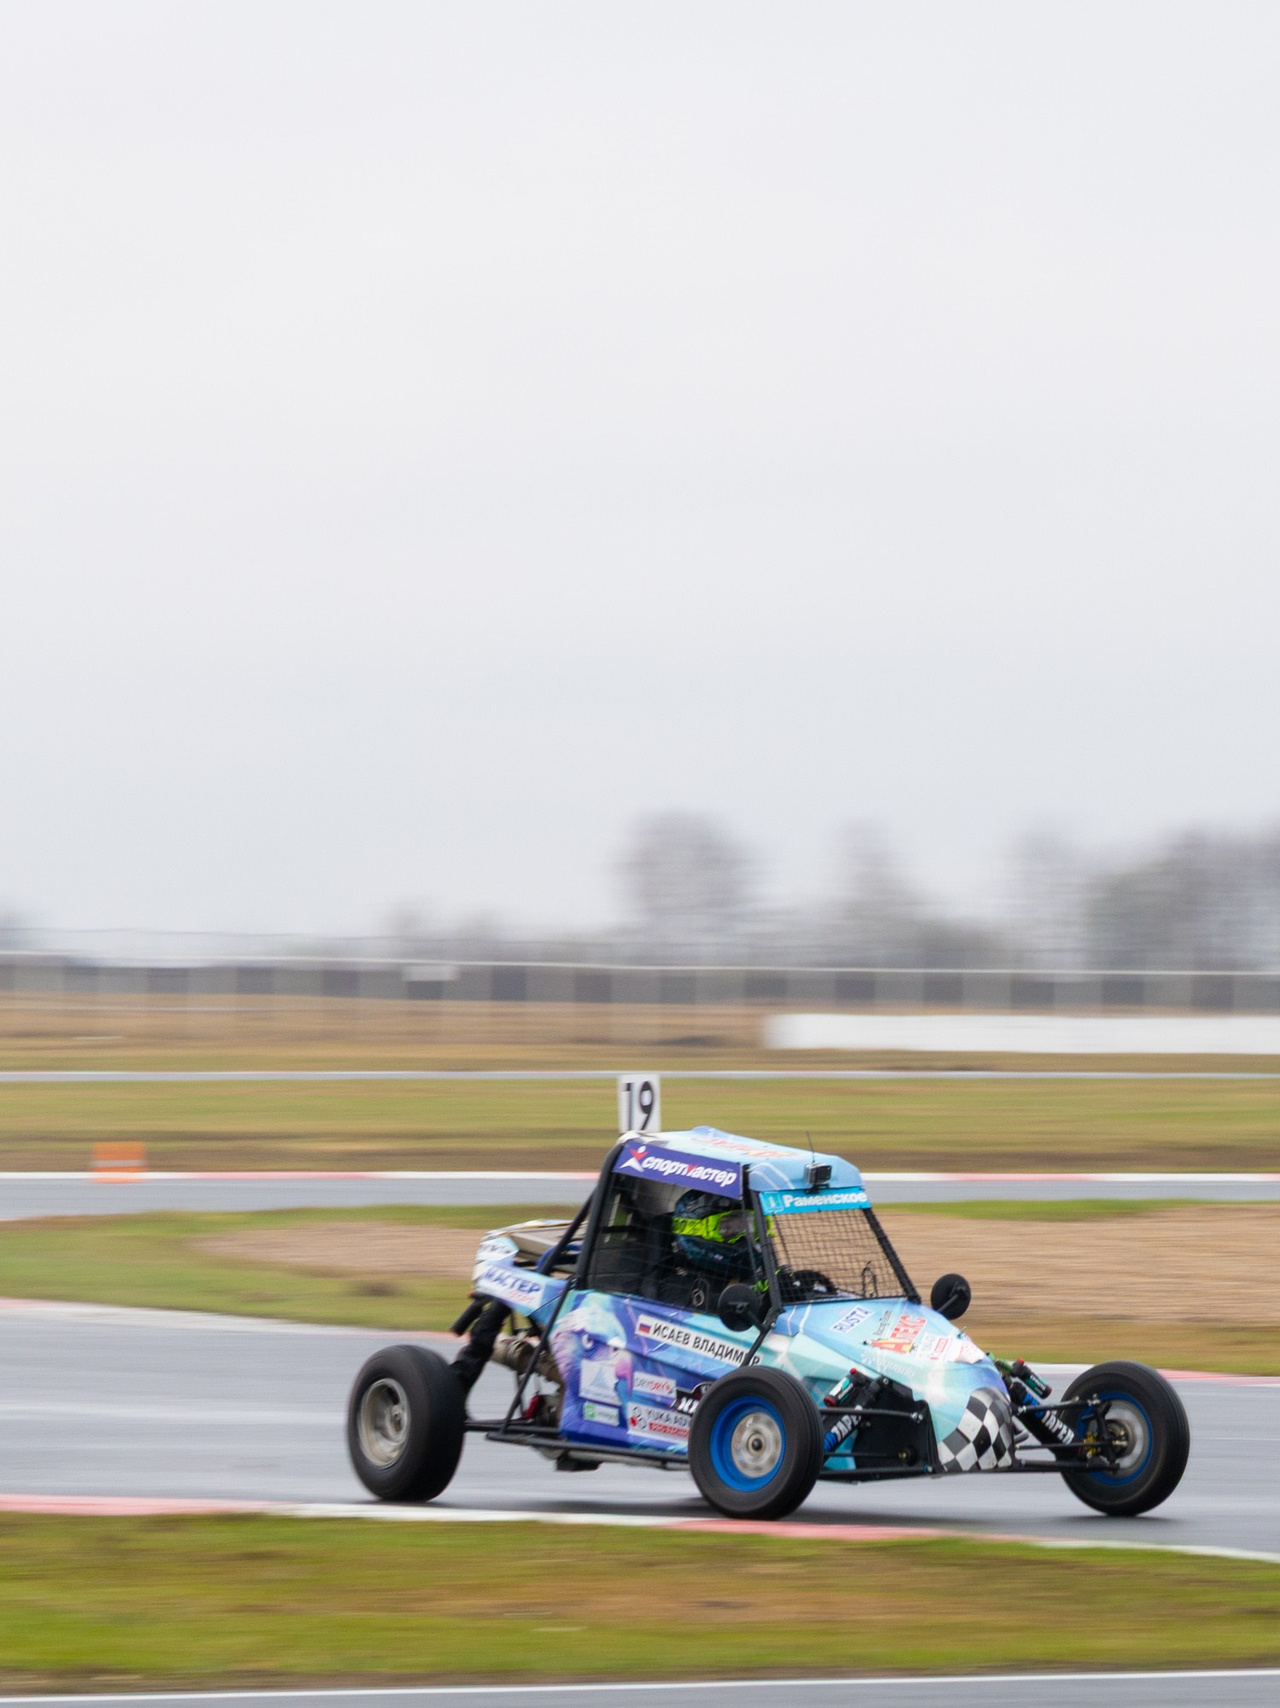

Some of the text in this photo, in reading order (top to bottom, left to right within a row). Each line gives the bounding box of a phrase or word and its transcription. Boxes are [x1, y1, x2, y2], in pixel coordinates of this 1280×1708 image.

[622, 1081, 654, 1131] 19
[641, 1156, 738, 1187] спортмастер
[783, 1191, 868, 1208] Раменское
[652, 1322, 760, 1365] ИСАЕВ ВЛАДИМР
